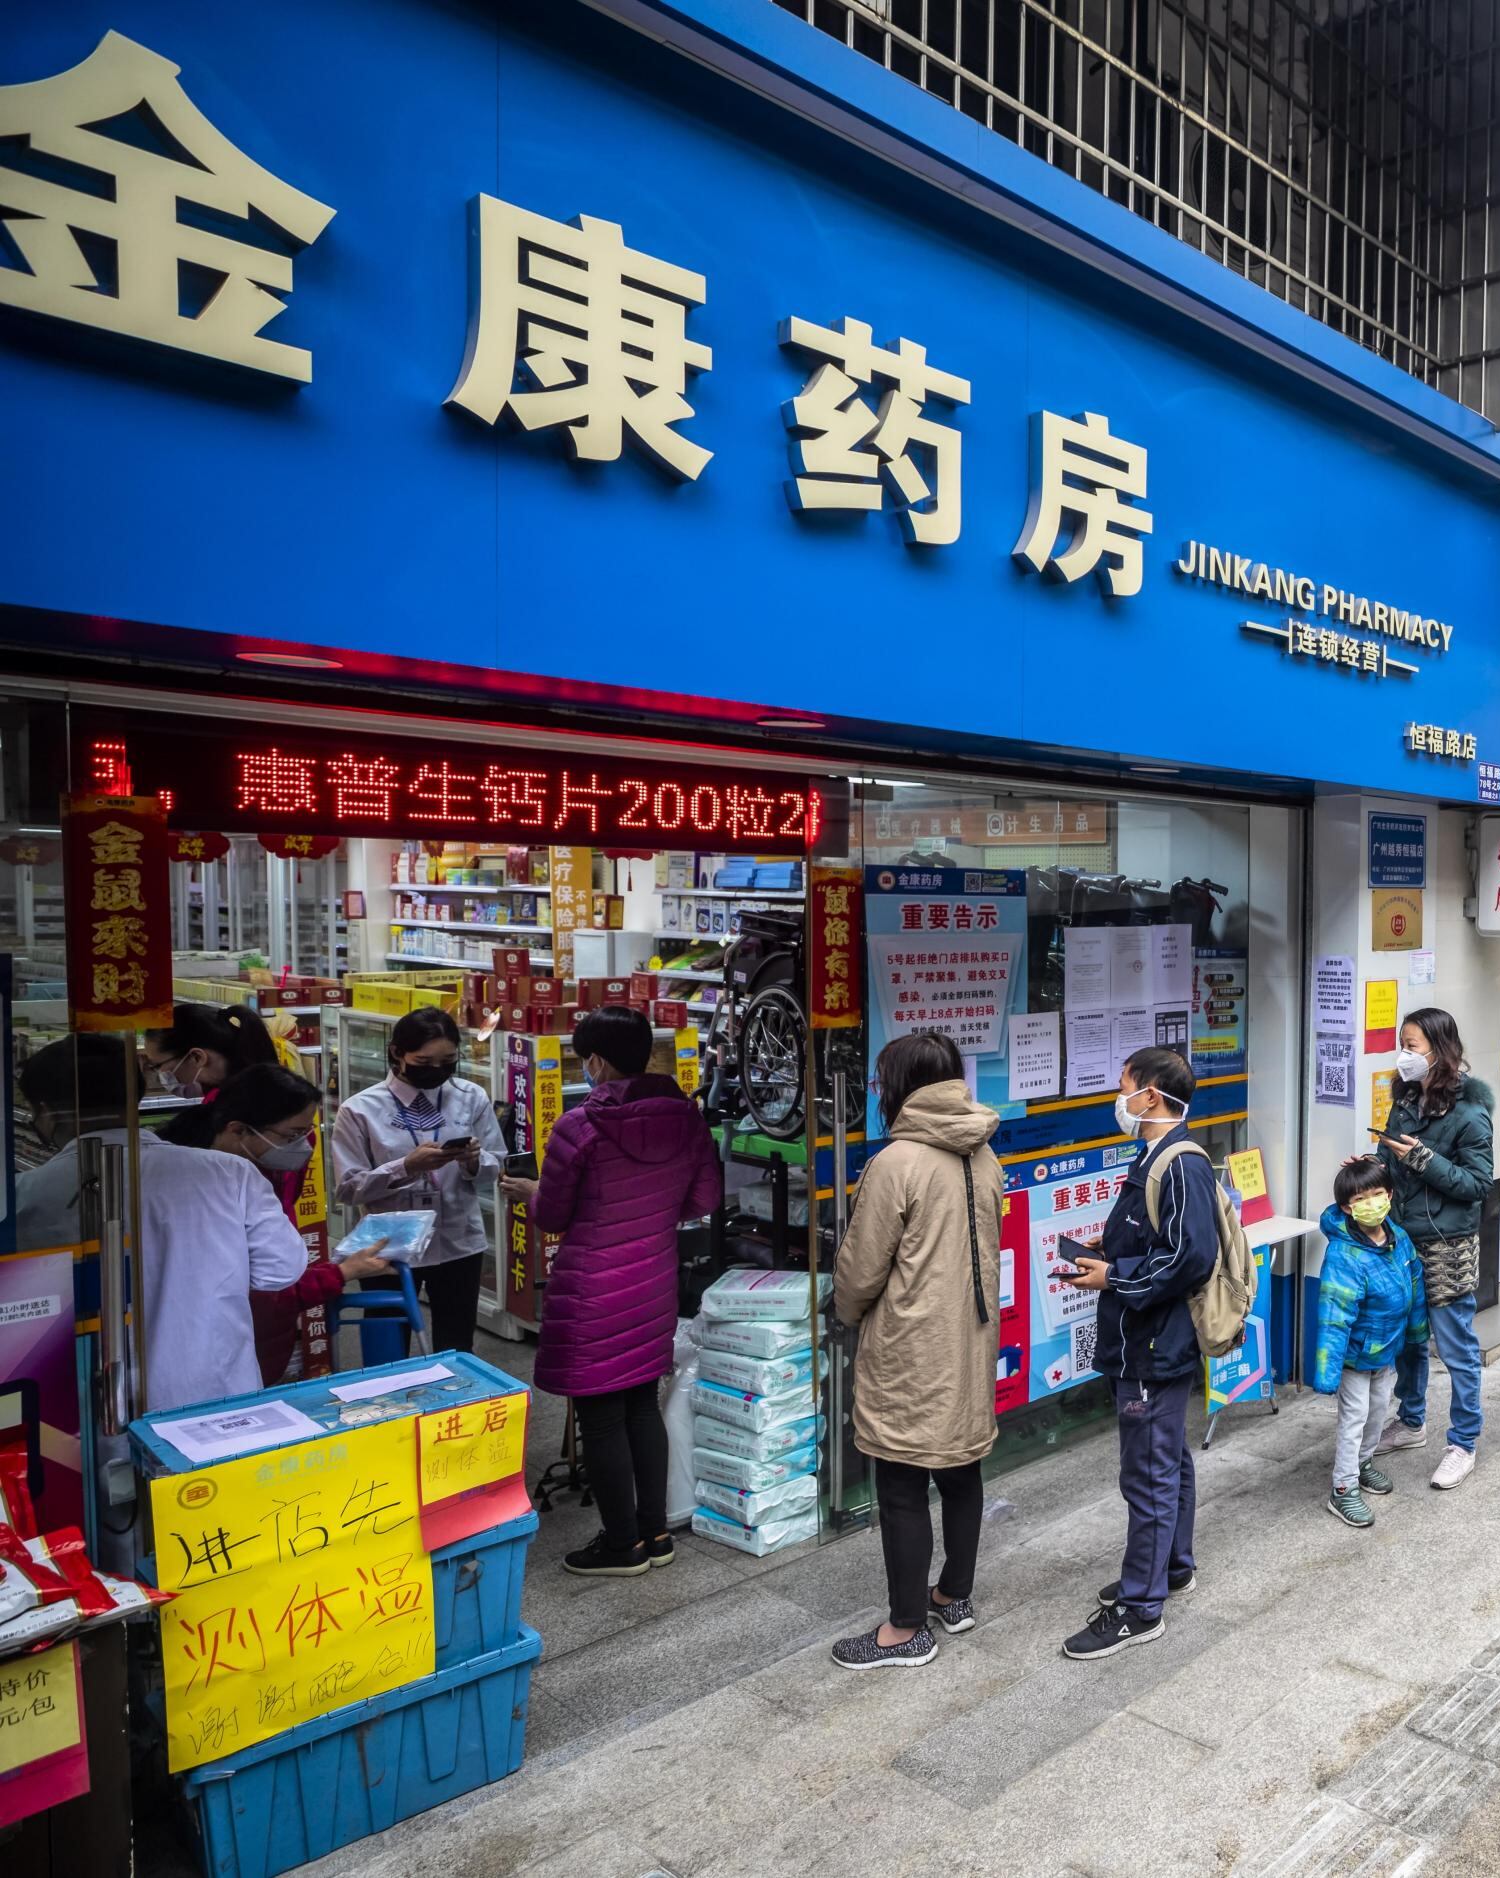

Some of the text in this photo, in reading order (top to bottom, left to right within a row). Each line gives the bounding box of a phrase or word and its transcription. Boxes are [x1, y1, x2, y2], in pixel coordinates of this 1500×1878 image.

[0, 29, 1153, 596] 金康药房
[1178, 540, 1453, 651] JINKANG PHARMACY
[1296, 623, 1380, 673] 连锁经营
[1408, 722, 1477, 760] 恒福路店
[1479, 765, 1500, 780] 恒福路
[1007, 812, 1089, 834] 计生用品
[898, 873, 943, 887] 金康药房
[901, 903, 998, 930] 重要告示
[887, 951, 1009, 966] 5号起拒绝门店排队购买口
[890, 969, 1008, 985] 罩，严禁聚集，避免交叉
[893, 1004, 999, 1022] 每天早上8点开始扫码，
[1050, 1157, 1086, 1174] 金康药房
[433, 1400, 508, 1446] 进店
[426, 1437, 512, 1483] 测体温
[168, 1477, 416, 1590] 进店先
